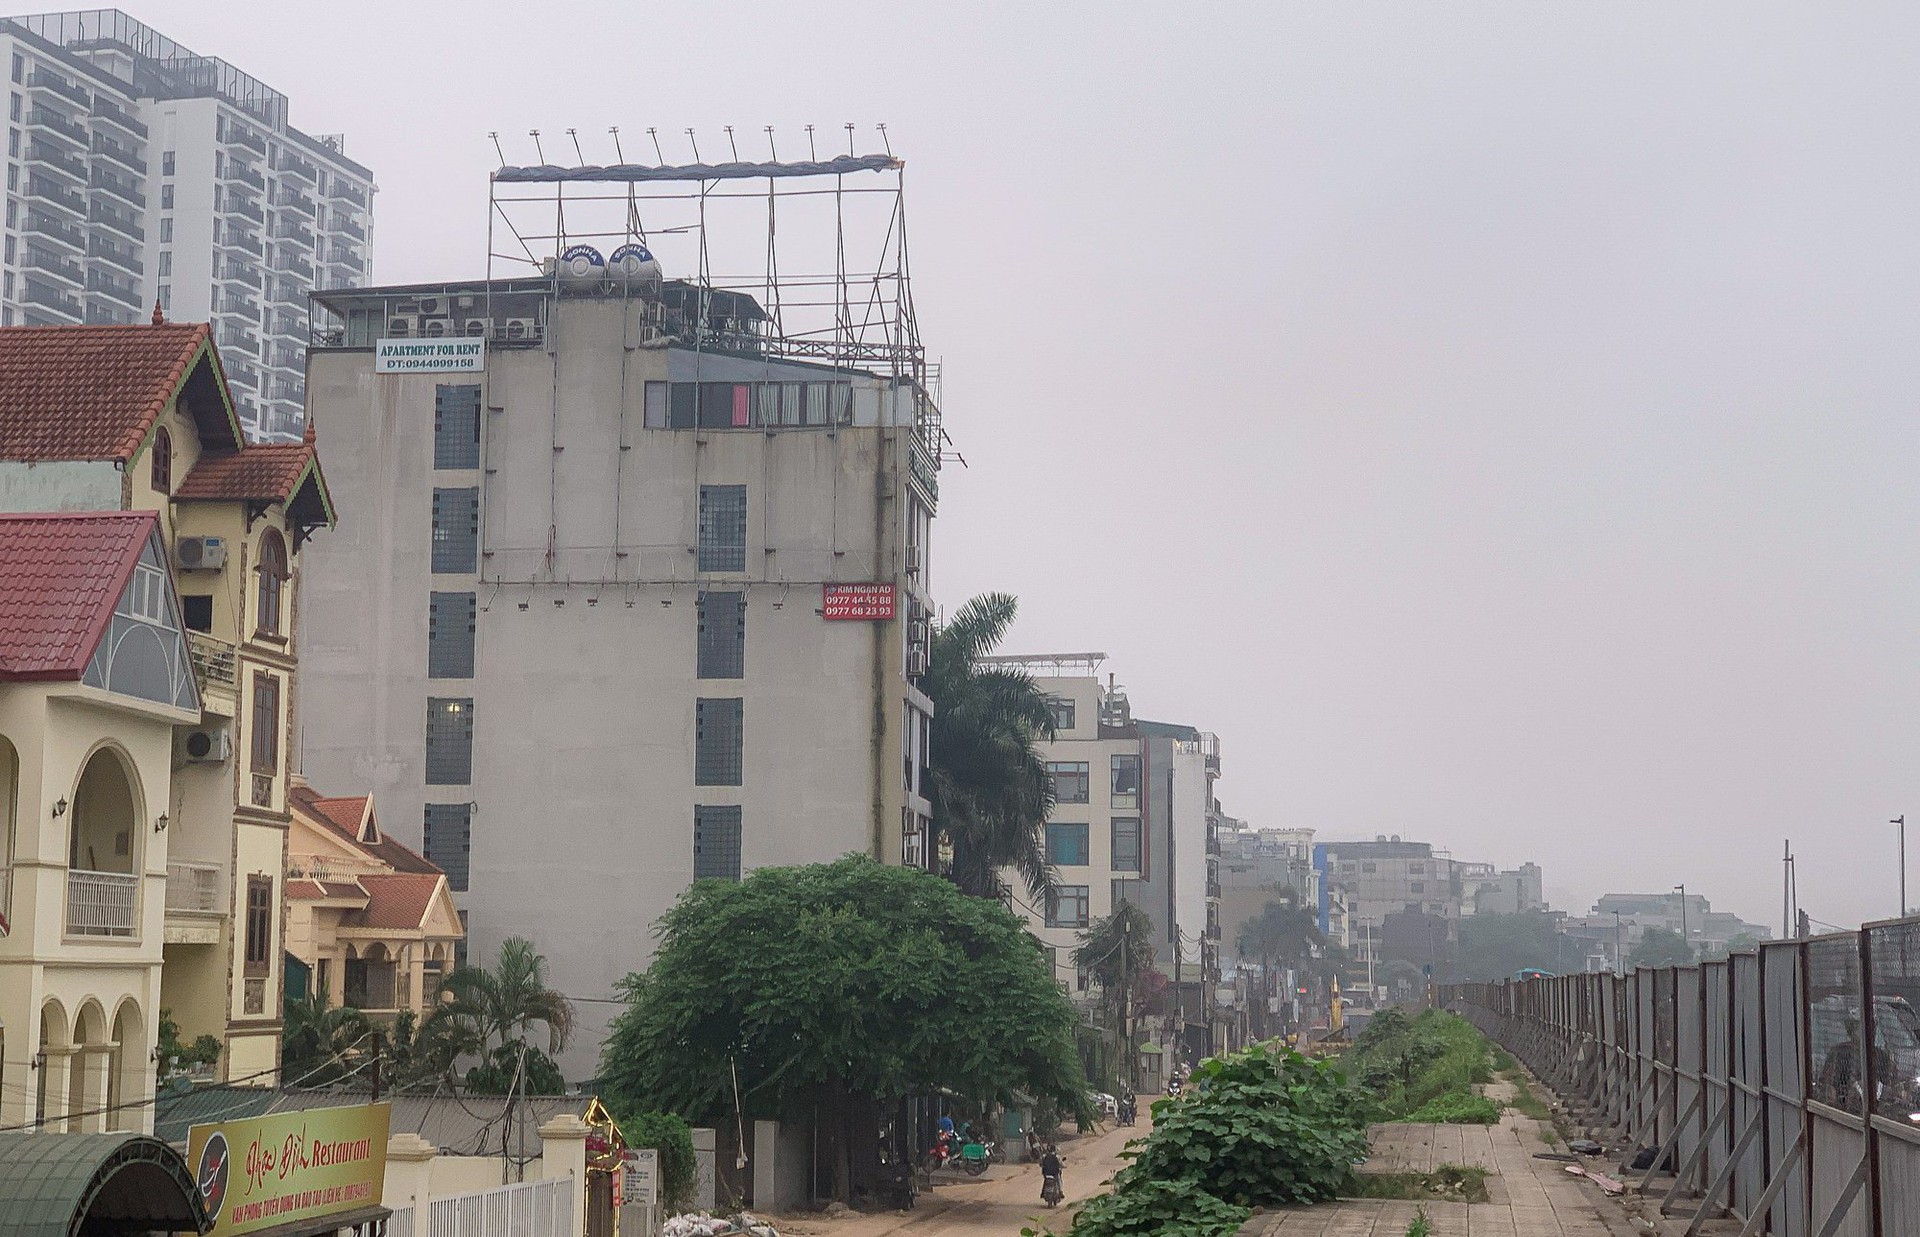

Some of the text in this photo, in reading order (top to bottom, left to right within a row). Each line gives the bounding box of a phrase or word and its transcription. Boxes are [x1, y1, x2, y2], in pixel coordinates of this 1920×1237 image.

[381, 344, 480, 356] APARTMENT FOR RENT
[826, 607, 891, 615] 0977 68 23 93
[312, 1137, 371, 1168] Restaurant
